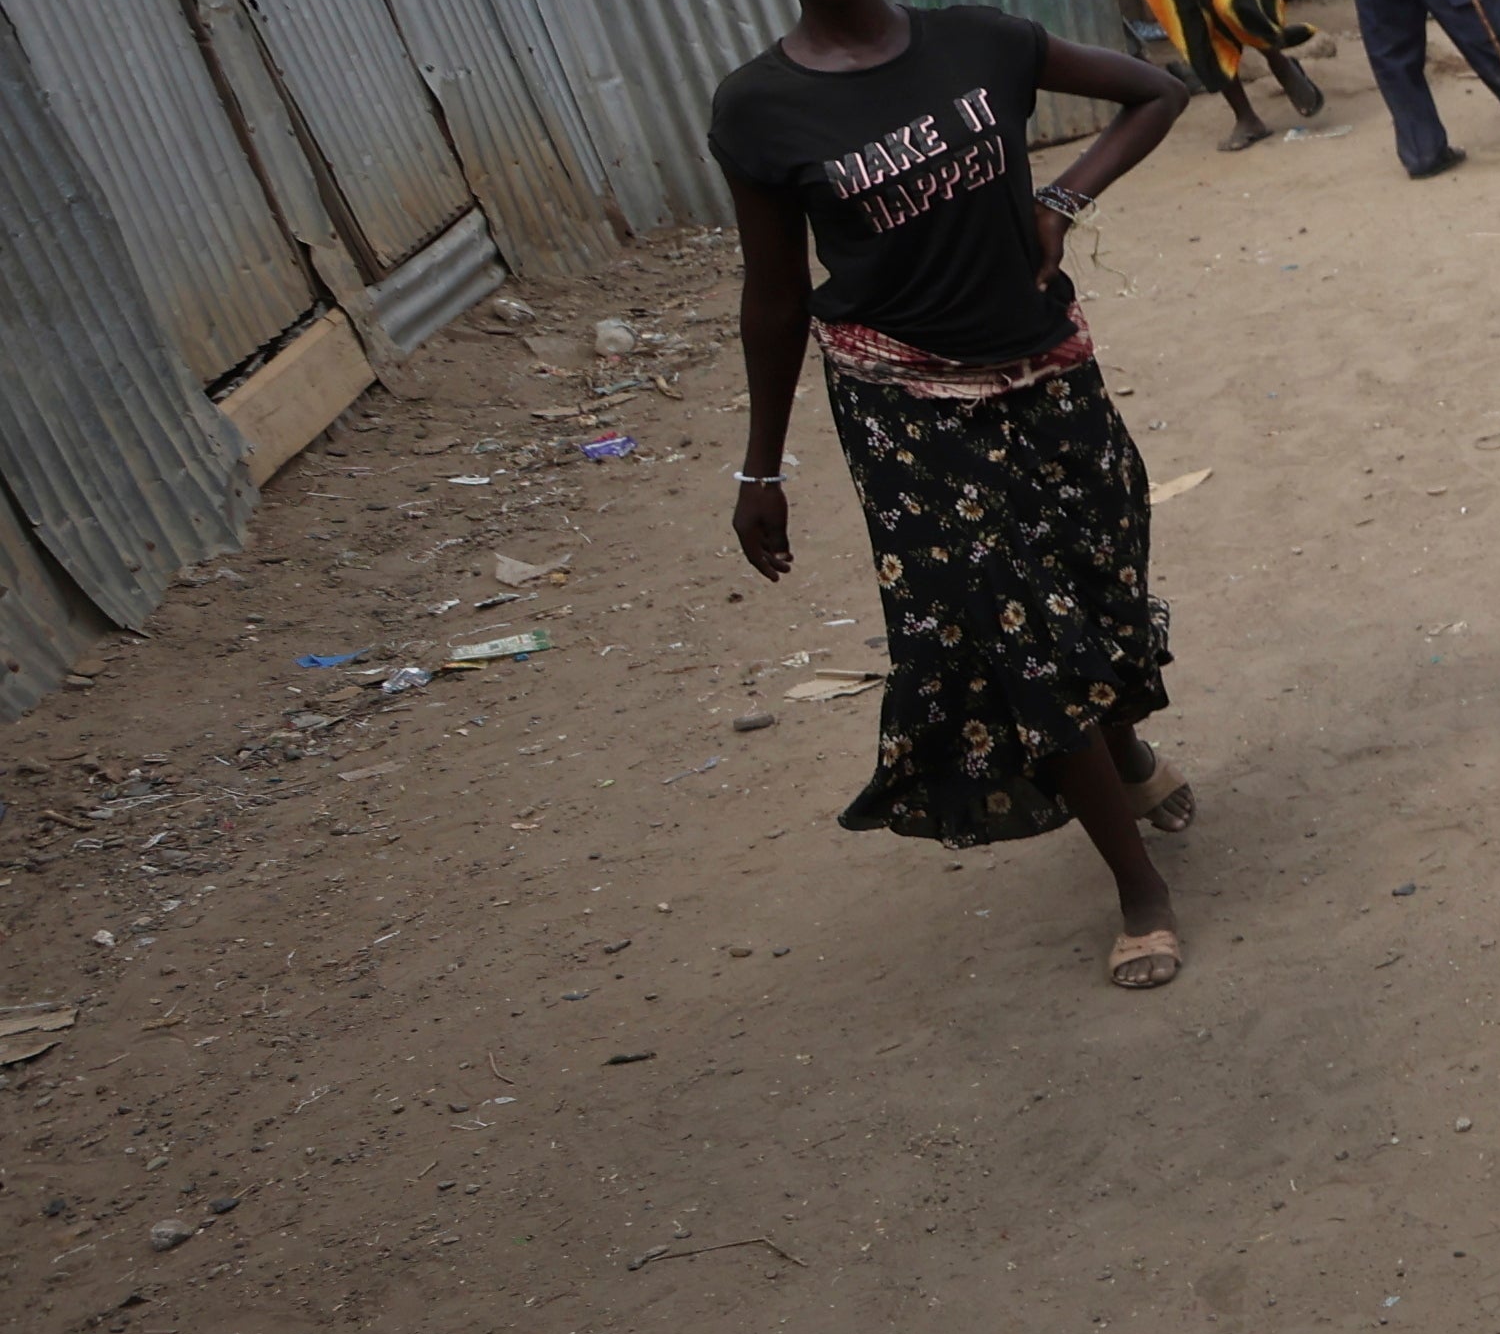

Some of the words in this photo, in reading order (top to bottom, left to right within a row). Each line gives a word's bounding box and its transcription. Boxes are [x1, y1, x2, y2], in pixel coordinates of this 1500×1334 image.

[823, 114, 948, 200] MAKE
[953, 87, 997, 133] IT
[862, 135, 1006, 234] HAPPEN
